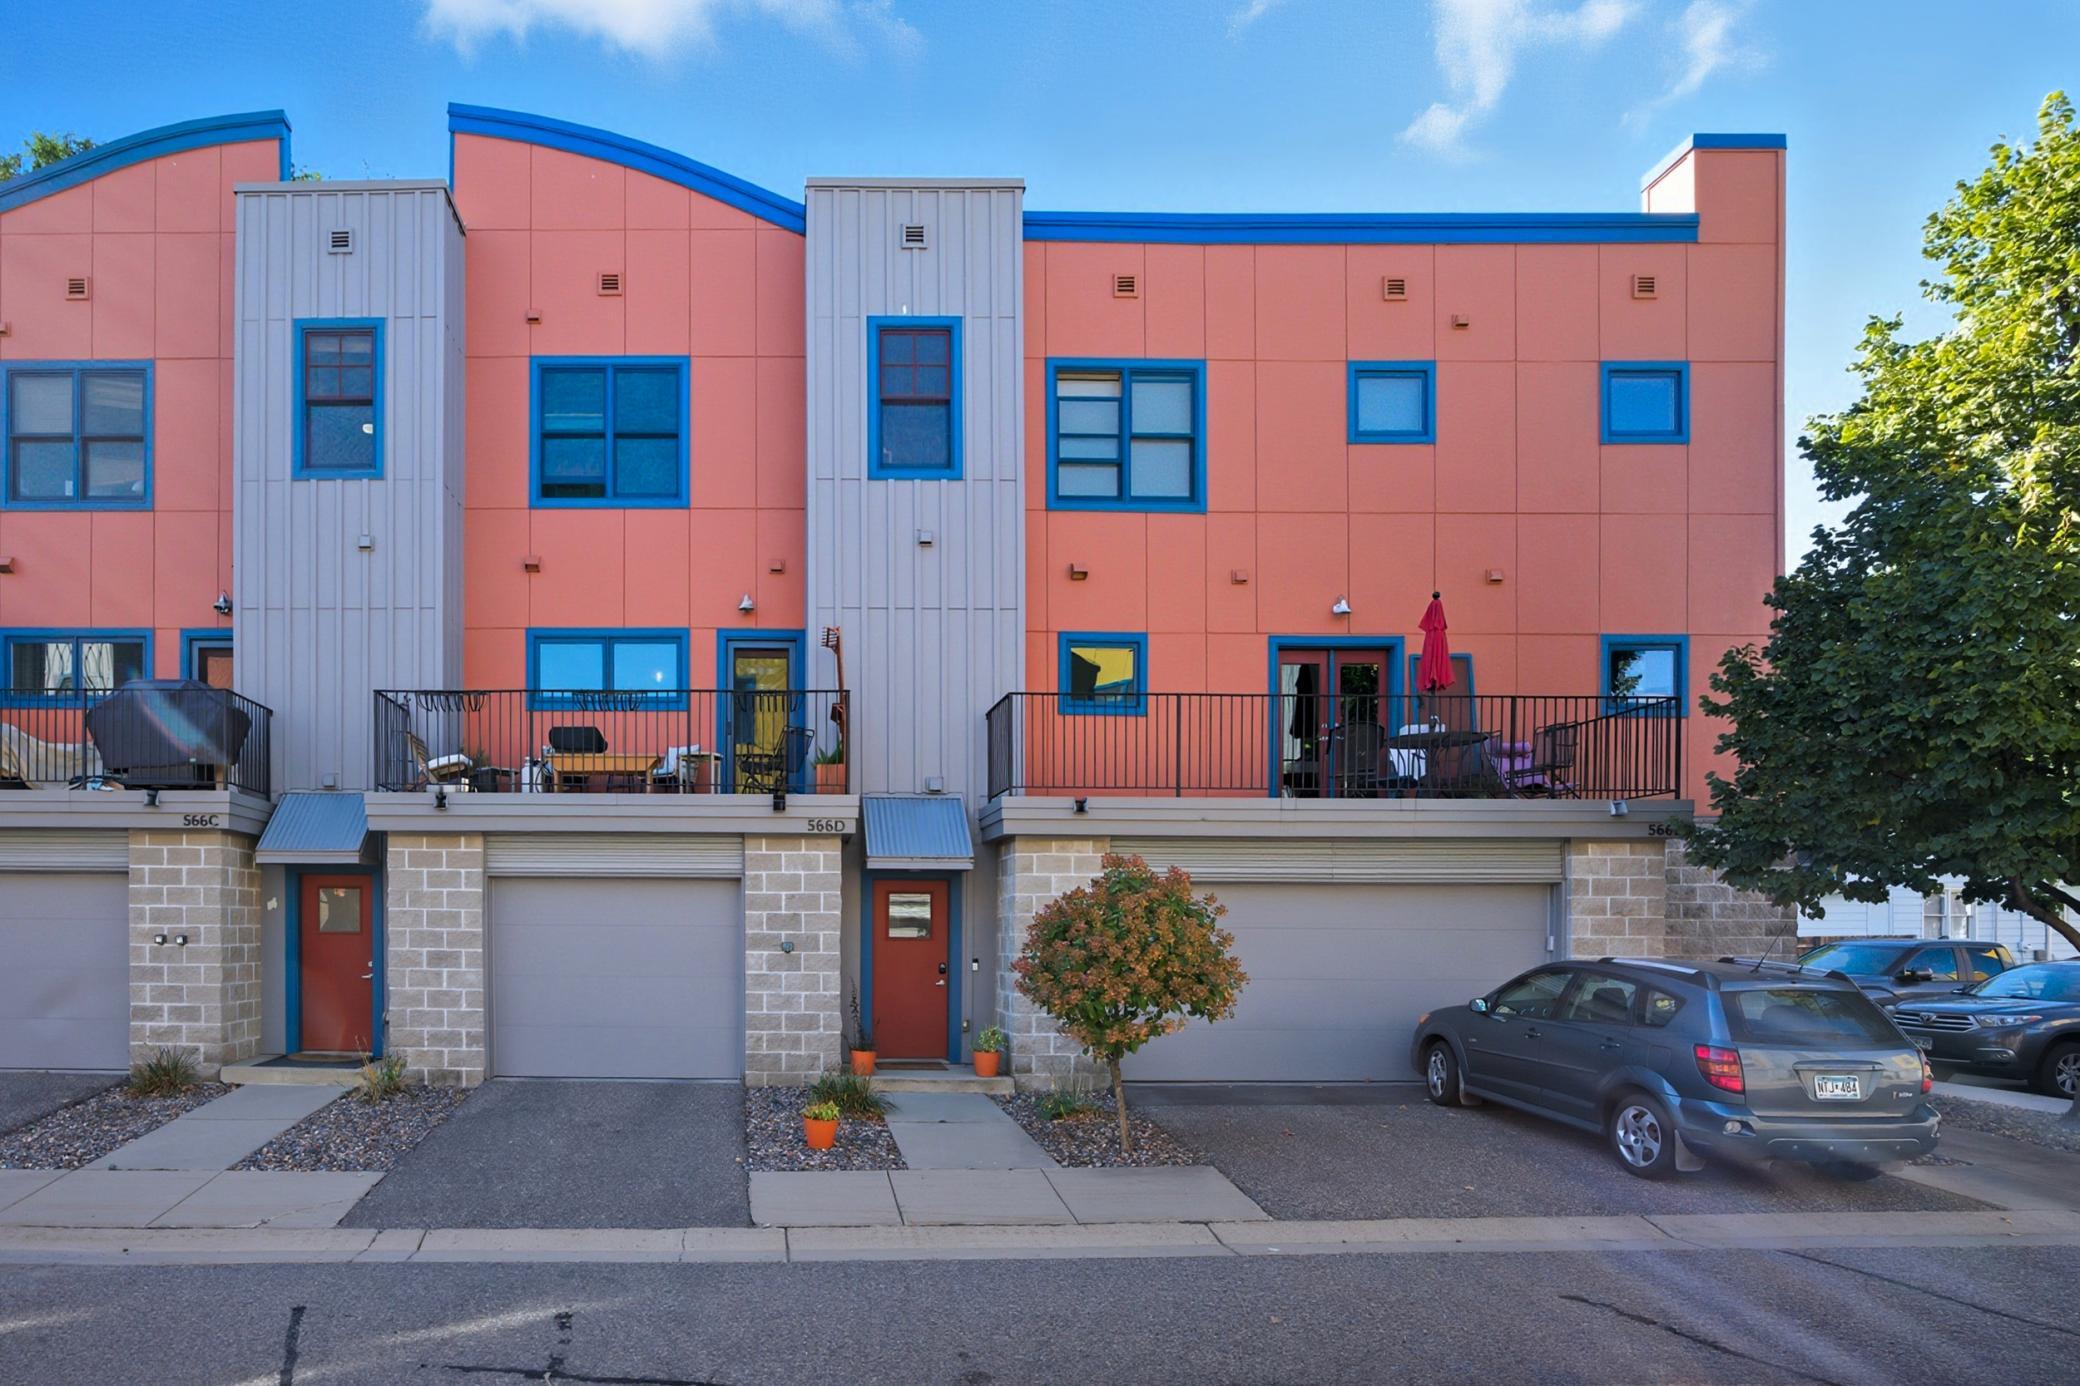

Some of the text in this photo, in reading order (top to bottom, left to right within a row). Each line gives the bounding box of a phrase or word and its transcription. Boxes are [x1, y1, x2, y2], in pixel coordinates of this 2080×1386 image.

[183, 814, 219, 827] 566C
[807, 819, 845, 832] 566D
[1648, 823, 1679, 836] 566
